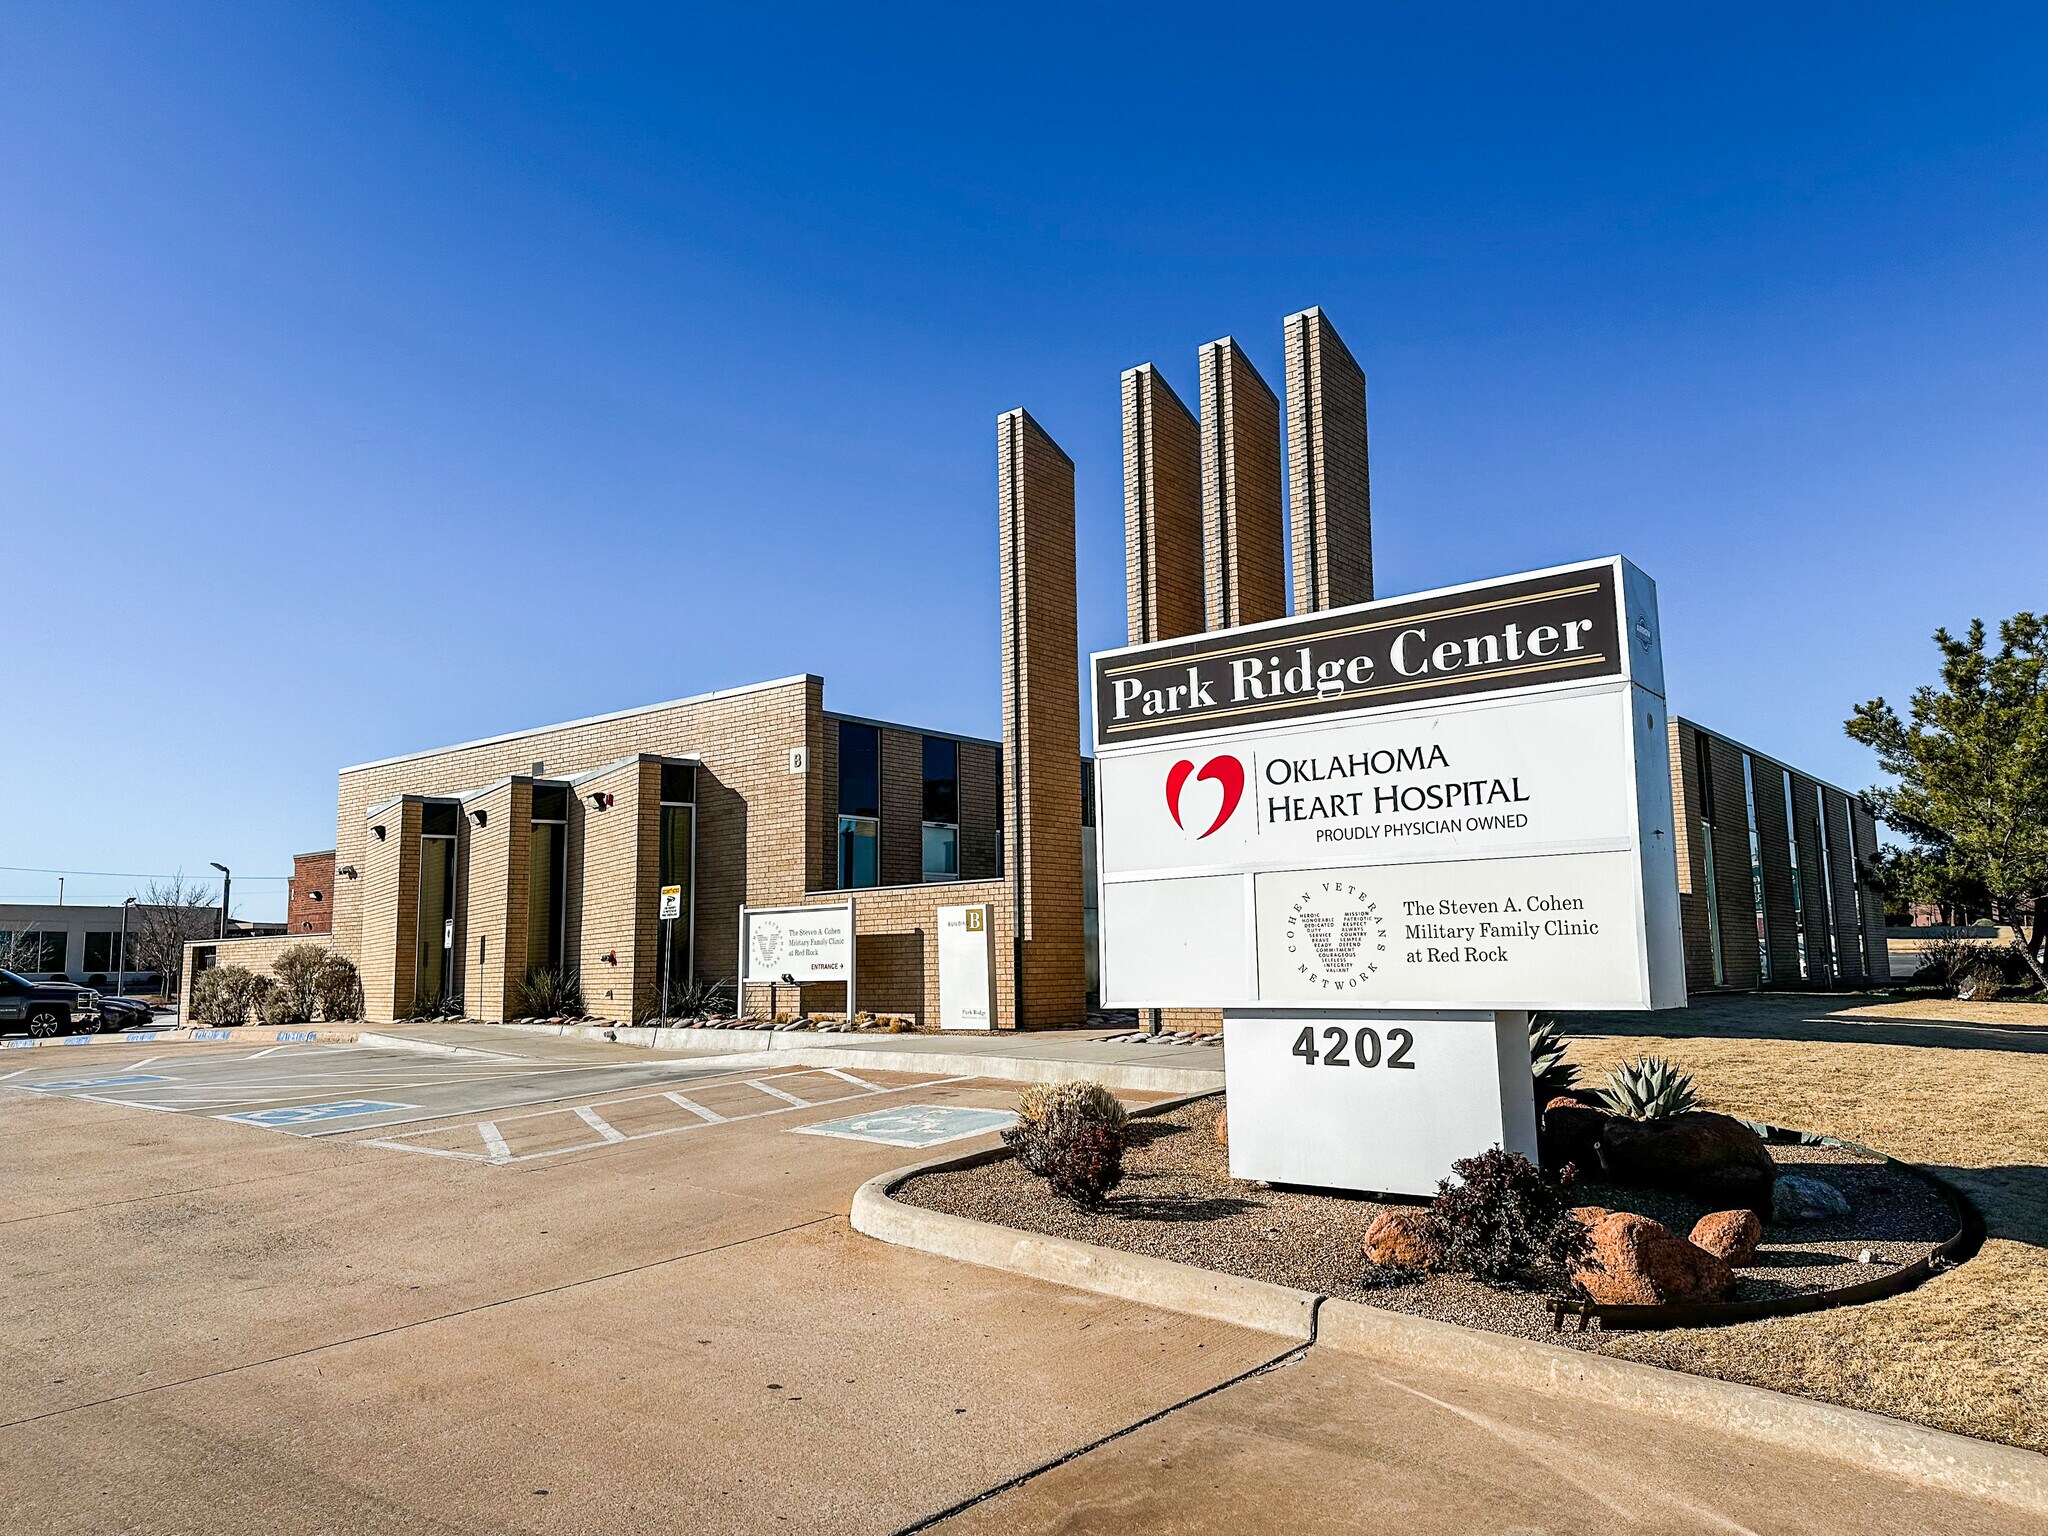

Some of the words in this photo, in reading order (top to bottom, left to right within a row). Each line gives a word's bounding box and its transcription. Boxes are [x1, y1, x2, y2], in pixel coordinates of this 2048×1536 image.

[1111, 666, 1218, 720] Park
[1228, 647, 1375, 701] Ridge
[1390, 618, 1593, 677] Center
[794, 753, 802, 768] B
[1266, 744, 1450, 786] OKLAHOMA
[1268, 792, 1363, 823] HEART
[1374, 777, 1531, 814] HOSPITAL
[1316, 825, 1380, 842] PROUDLY
[1384, 819, 1462, 837] PHYSICIAN
[1466, 813, 1528, 831] OWNED
[1322, 882, 1386, 952] VETERANS
[1403, 900, 1435, 916] The
[1439, 899, 1499, 915] Steven
[1503, 896, 1522, 913] A.
[1527, 894, 1585, 912] Cohen
[799, 928, 817, 936] Steven
[824, 927, 841, 935] Cohen
[969, 912, 980, 929] B
[1286, 892, 1311, 953] COHEN
[1405, 923, 1476, 942] Military
[1479, 920, 1540, 940] Family
[1544, 919, 1599, 936] Clinic
[1406, 949, 1423, 963] at
[1427, 946, 1460, 963] Red
[1464, 945, 1509, 962] Rock
[1298, 962, 1378, 990] NETWORK
[1292, 1026, 1416, 1070] 4202
